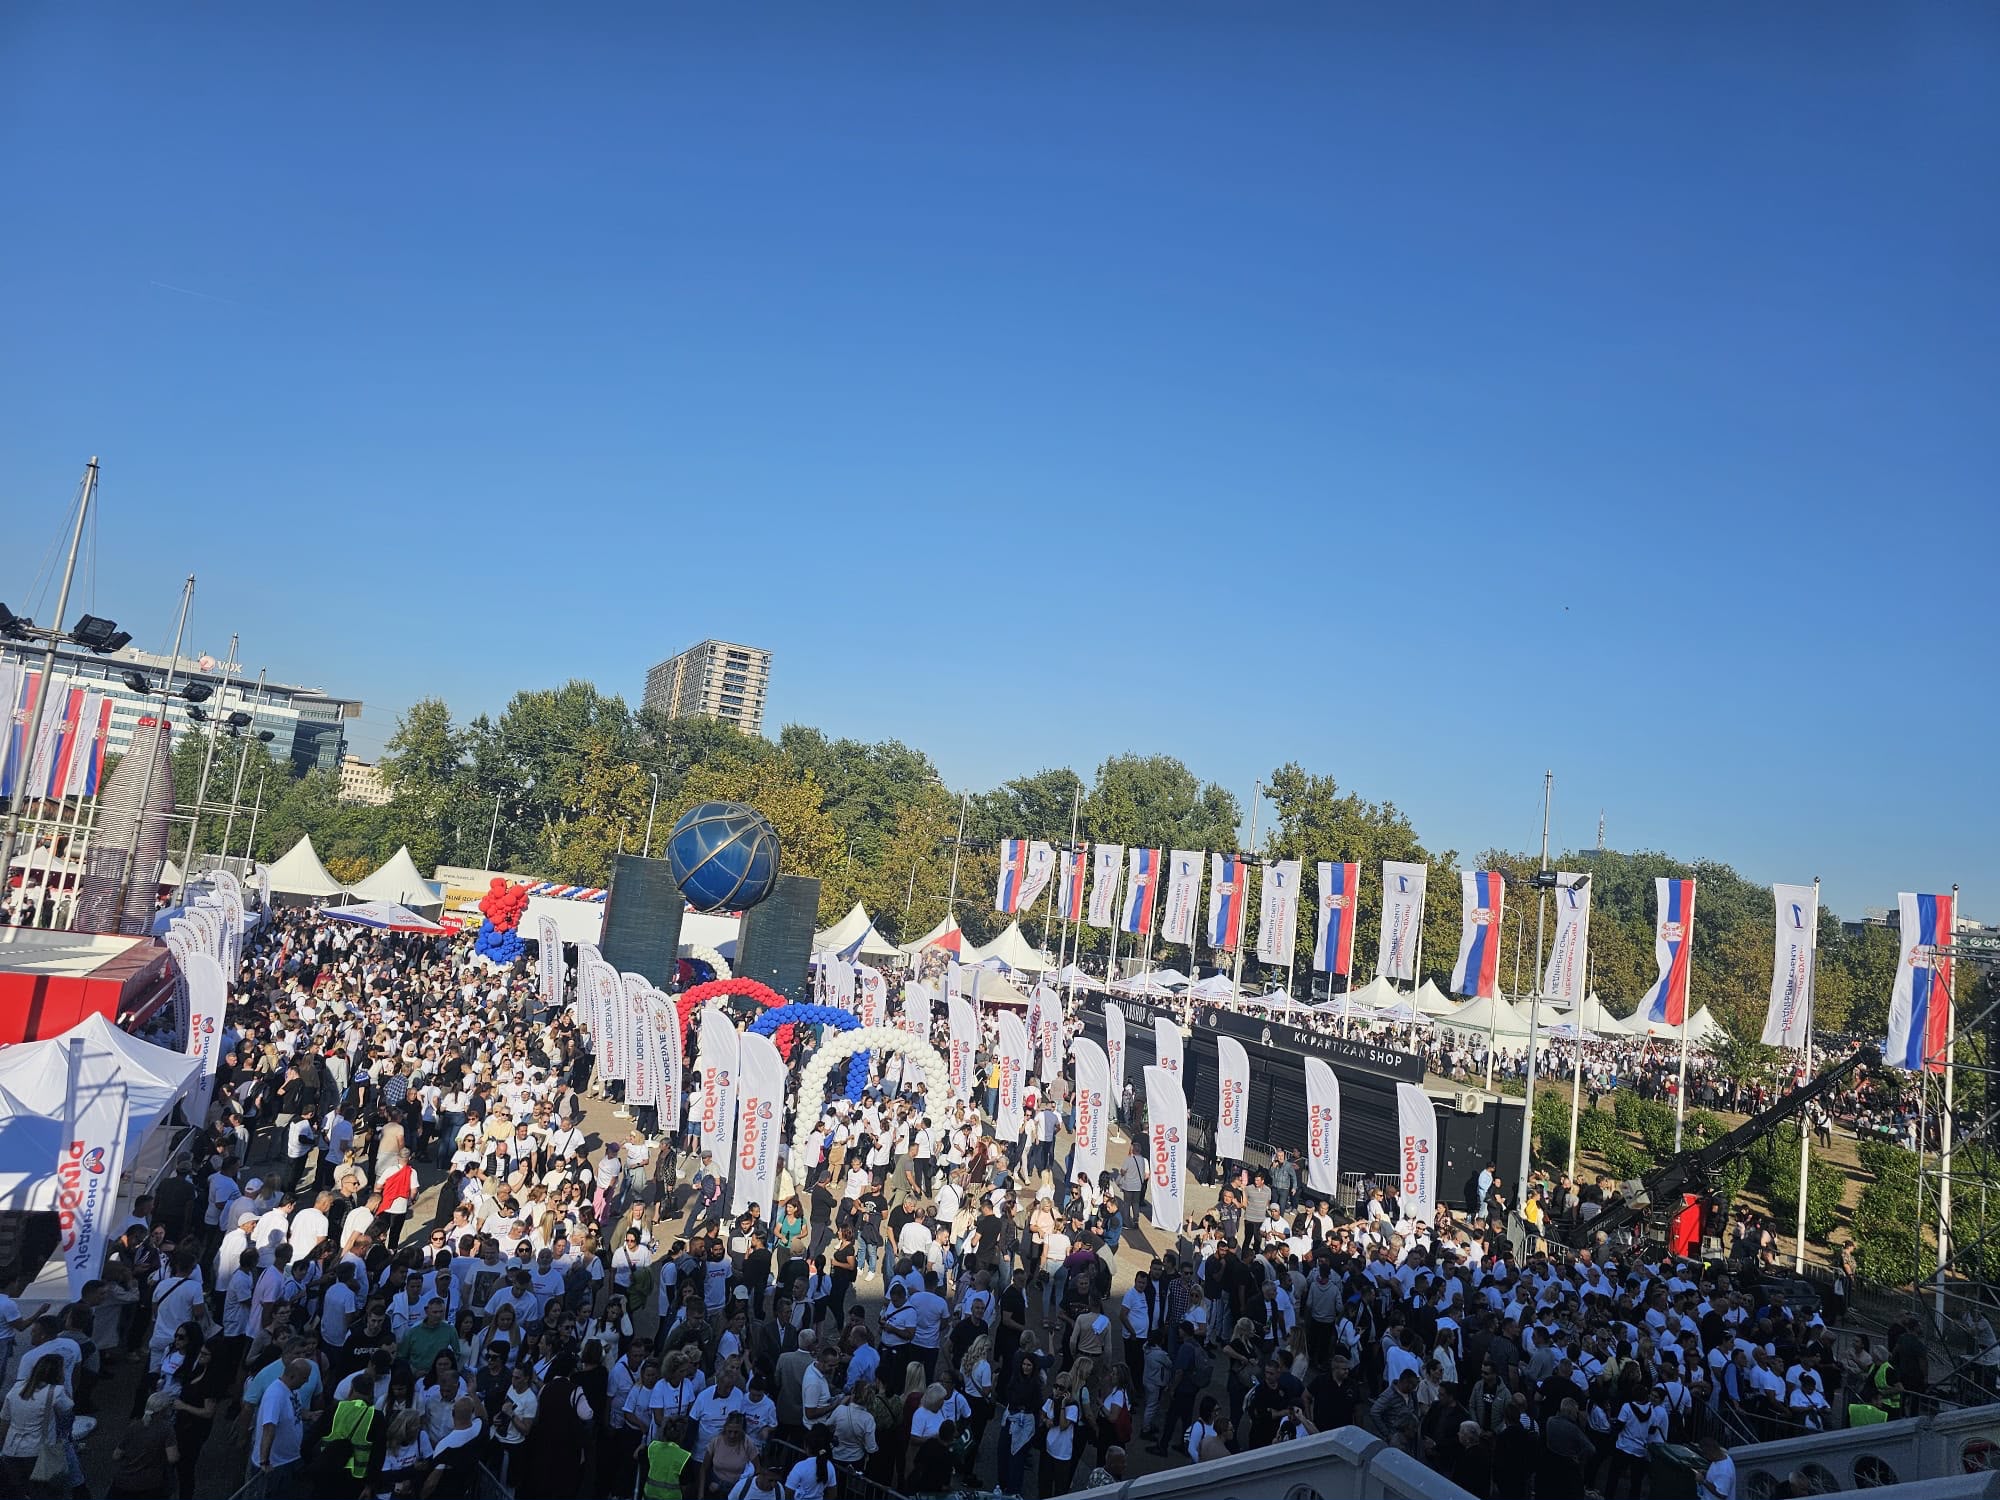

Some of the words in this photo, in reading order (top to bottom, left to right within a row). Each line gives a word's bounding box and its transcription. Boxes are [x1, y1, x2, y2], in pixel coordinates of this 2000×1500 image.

[1294, 1032, 1307, 1044] KK
[1310, 1036, 1366, 1060] PARTIZAN
[1369, 1049, 1402, 1068] SHOP
